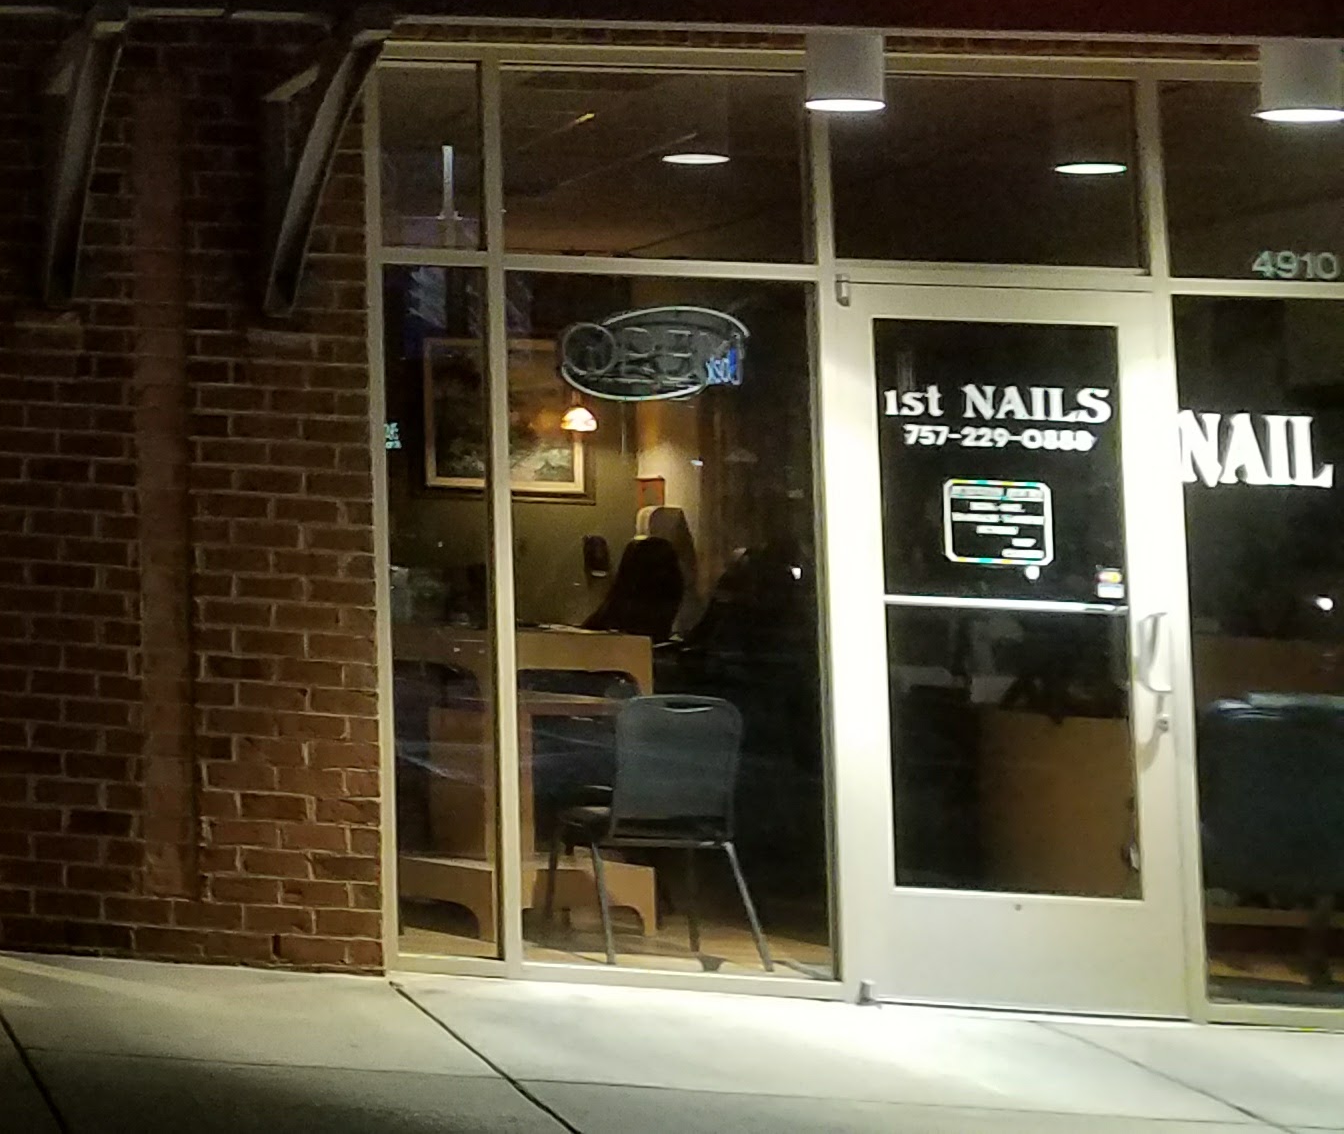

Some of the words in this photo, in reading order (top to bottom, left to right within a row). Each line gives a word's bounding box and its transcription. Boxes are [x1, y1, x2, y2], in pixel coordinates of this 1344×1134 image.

[1252, 251, 1340, 279] 4910
[961, 384, 1112, 424] NAILS
[1177, 409, 1334, 488] NAIL
